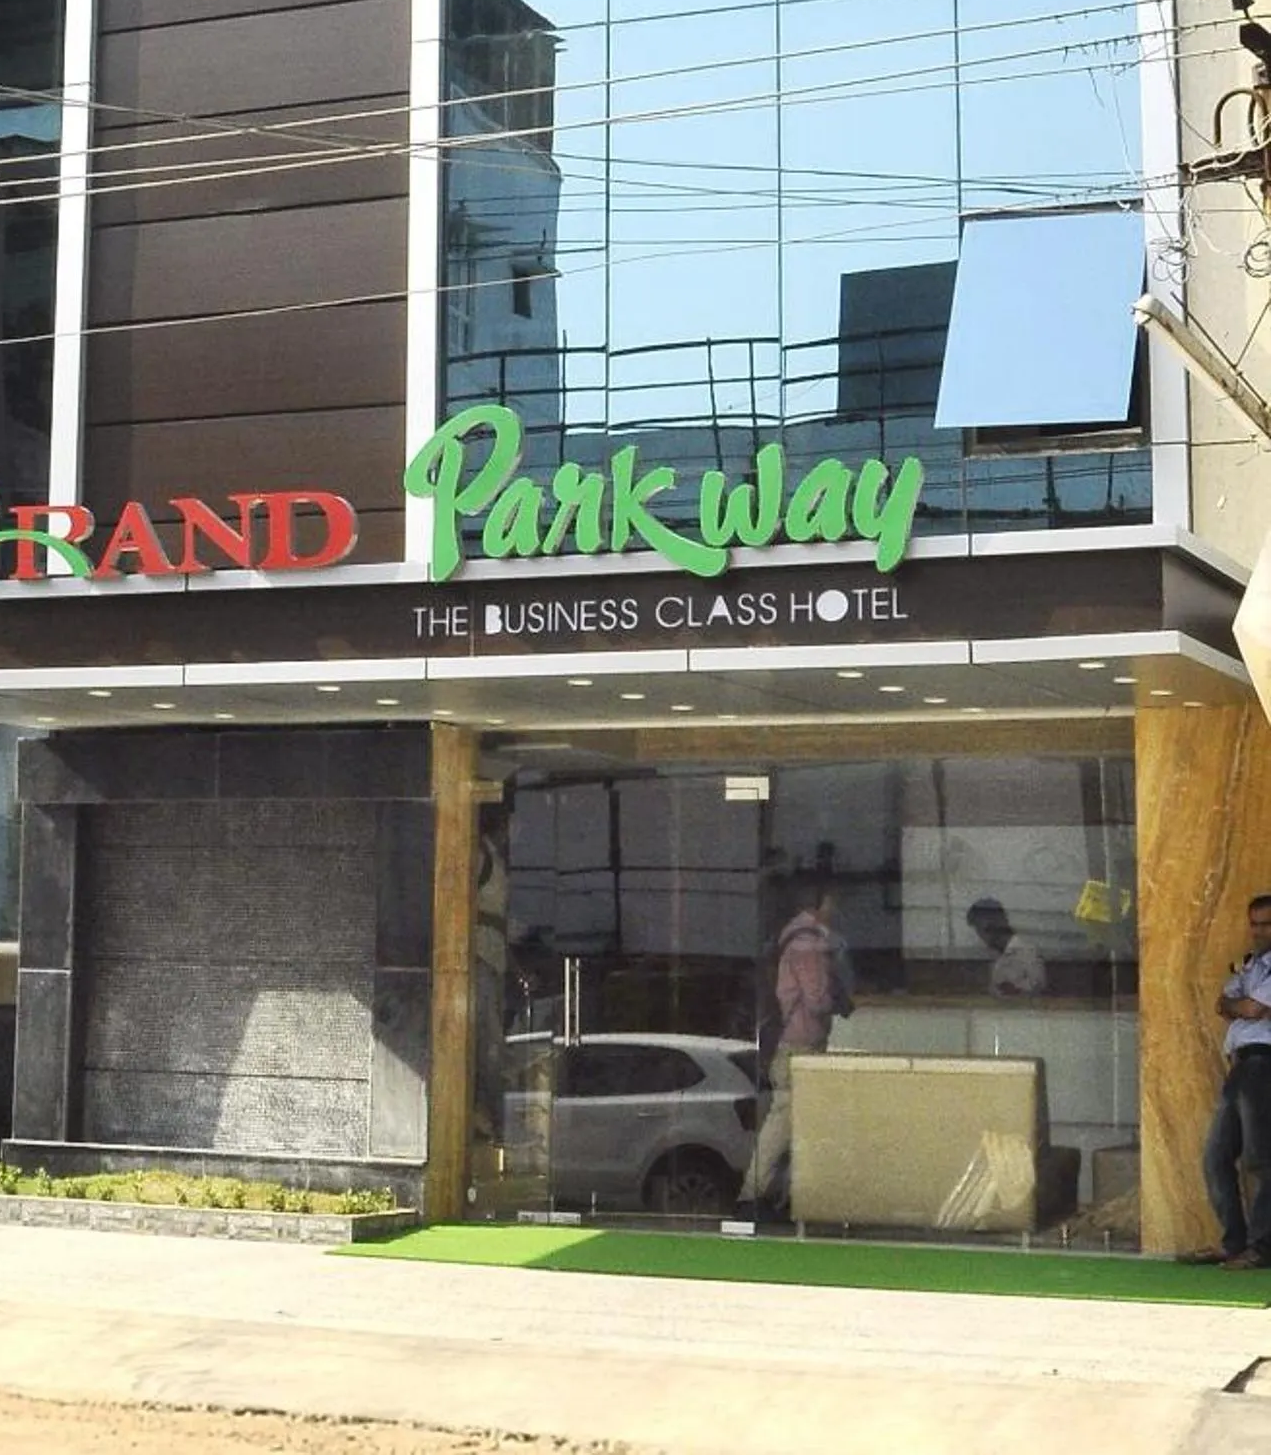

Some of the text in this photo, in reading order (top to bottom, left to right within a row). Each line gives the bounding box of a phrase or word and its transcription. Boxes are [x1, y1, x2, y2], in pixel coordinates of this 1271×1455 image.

[413, 588, 908, 637] THE BUSINESS CLASS HOTEL
